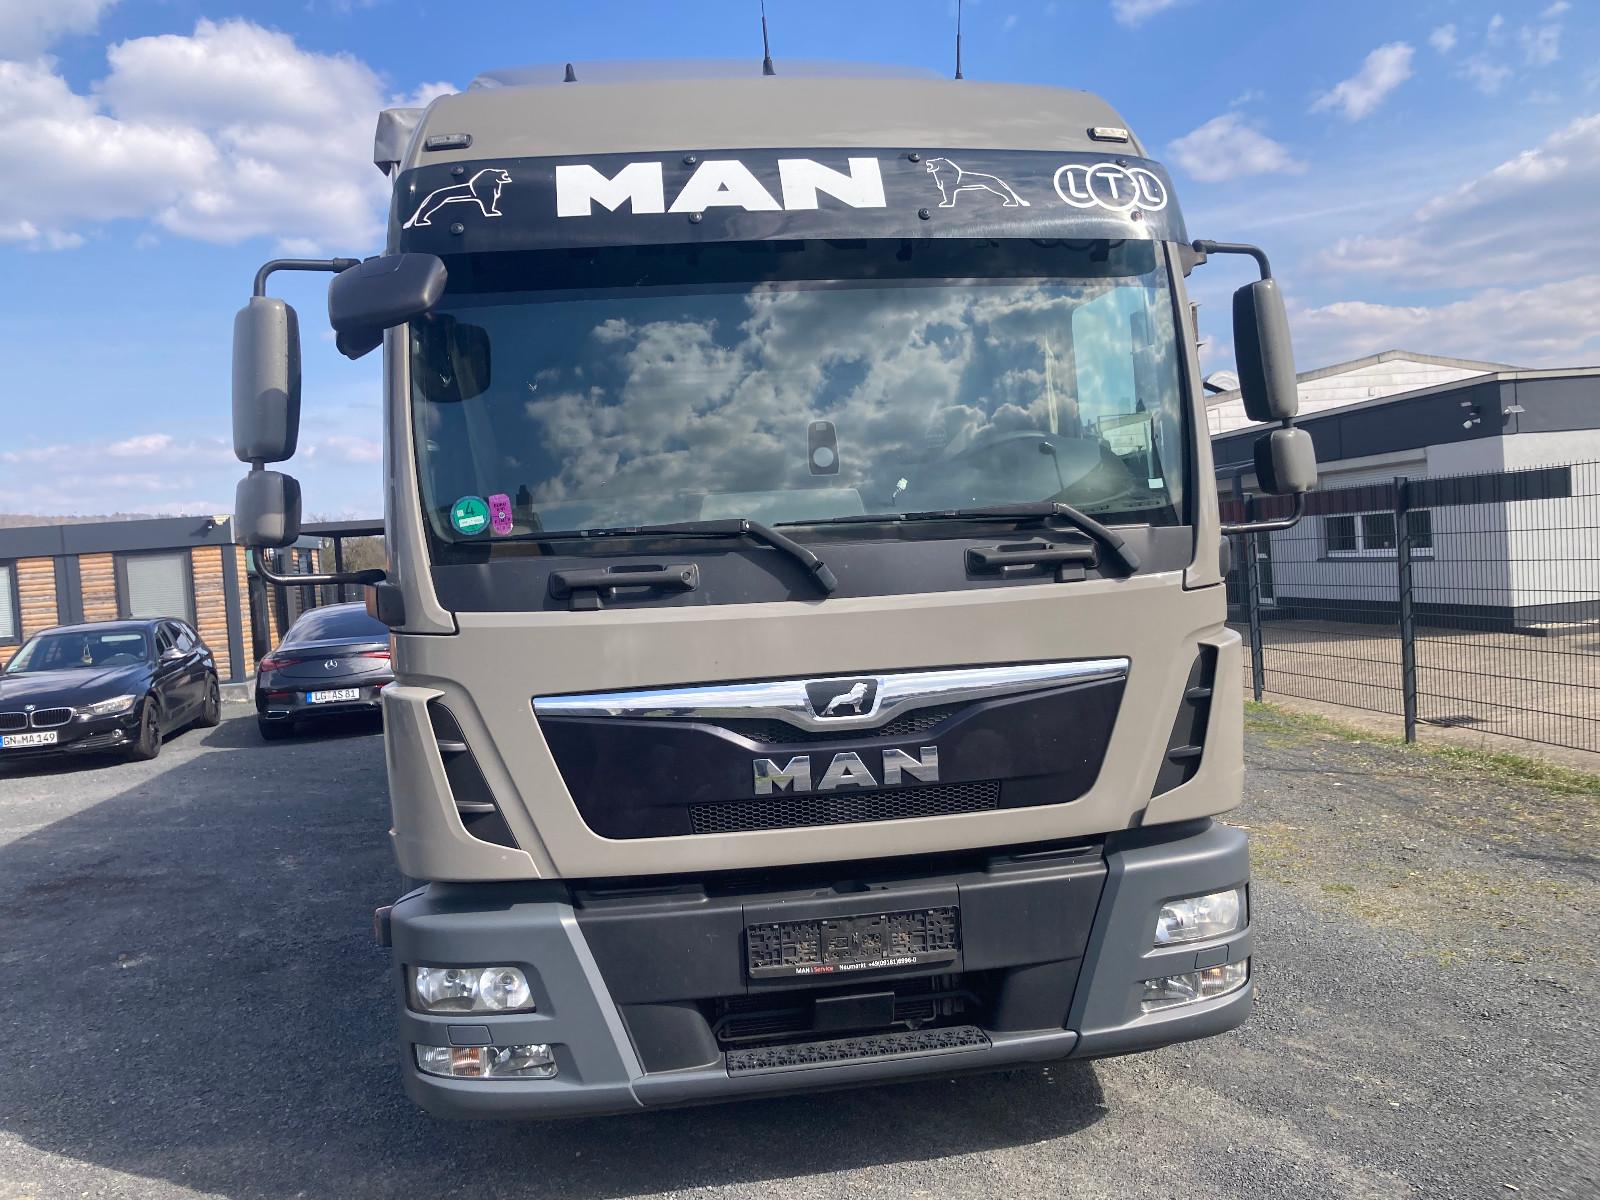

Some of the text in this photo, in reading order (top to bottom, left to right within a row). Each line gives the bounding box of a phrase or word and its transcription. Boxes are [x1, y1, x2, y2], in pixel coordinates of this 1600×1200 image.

[556, 157, 887, 217] MAN
[1065, 169, 1162, 204] LTL
[314, 689, 356, 701] LG AS 81
[3, 732, 56, 746] GN MA 149
[753, 745, 939, 795] MAN
[813, 966, 834, 974] Service
[839, 962, 867, 971] Neumarkt
